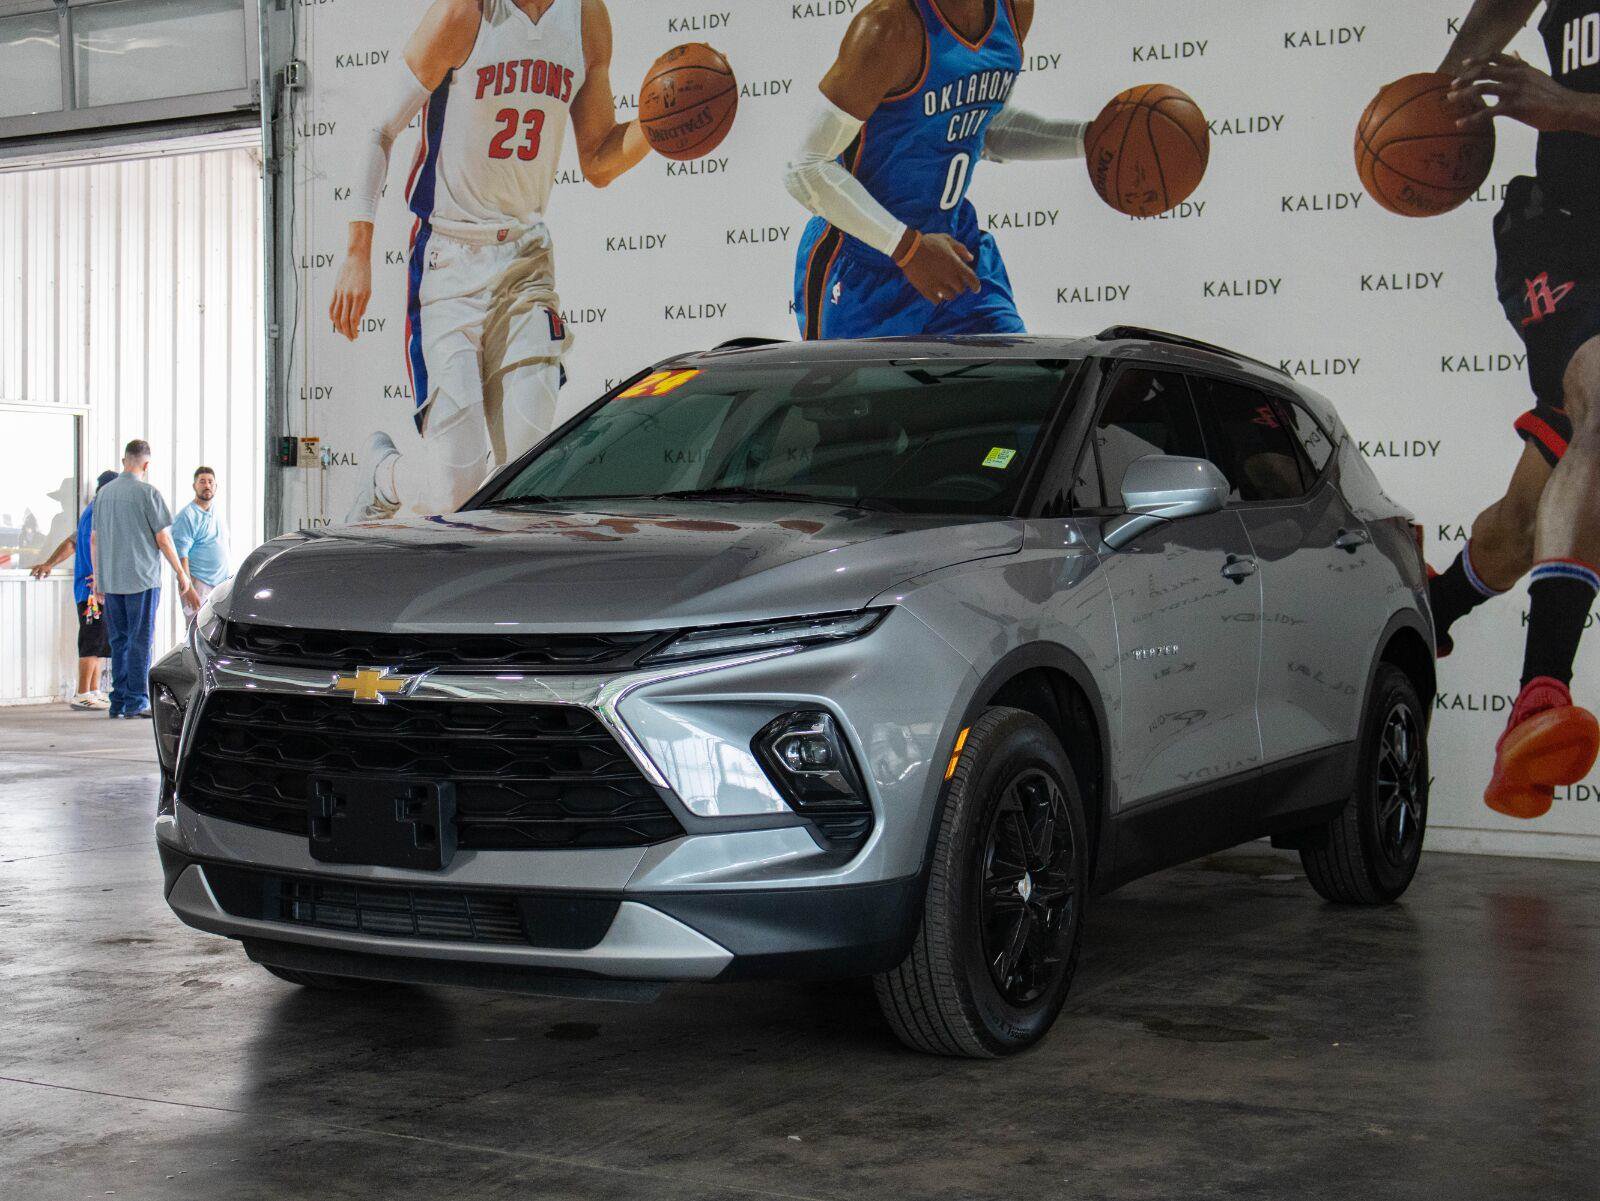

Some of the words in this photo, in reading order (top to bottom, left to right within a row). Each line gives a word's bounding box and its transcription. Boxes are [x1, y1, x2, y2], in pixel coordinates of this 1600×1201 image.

[793, 0, 857, 19] KALIDY
[668, 12, 731, 33] KALIDY
[1284, 26, 1366, 49] KALIDY
[336, 50, 389, 68] KALIDY
[1132, 41, 1209, 62] KALIDY
[475, 58, 574, 104] PISTONS
[488, 108, 545, 161] 23
[946, 109, 989, 142] CITY
[1207, 115, 1284, 135] KALIDY
[667, 158, 729, 177] KALIDY
[939, 152, 970, 211] 0
[1281, 192, 1363, 212] KALIDY
[988, 210, 1060, 230] KALIDY
[606, 234, 667, 252] KALIDY
[726, 226, 791, 245] KALIDY
[1203, 278, 1282, 298] KALIDY
[1360, 272, 1444, 292] KALIDY
[1056, 285, 1131, 304] KALIDY
[664, 303, 728, 320] KALIDY
[1280, 358, 1361, 376] KALIDY
[1441, 353, 1527, 372] KALIDY
[1359, 440, 1441, 457] KALIDY
